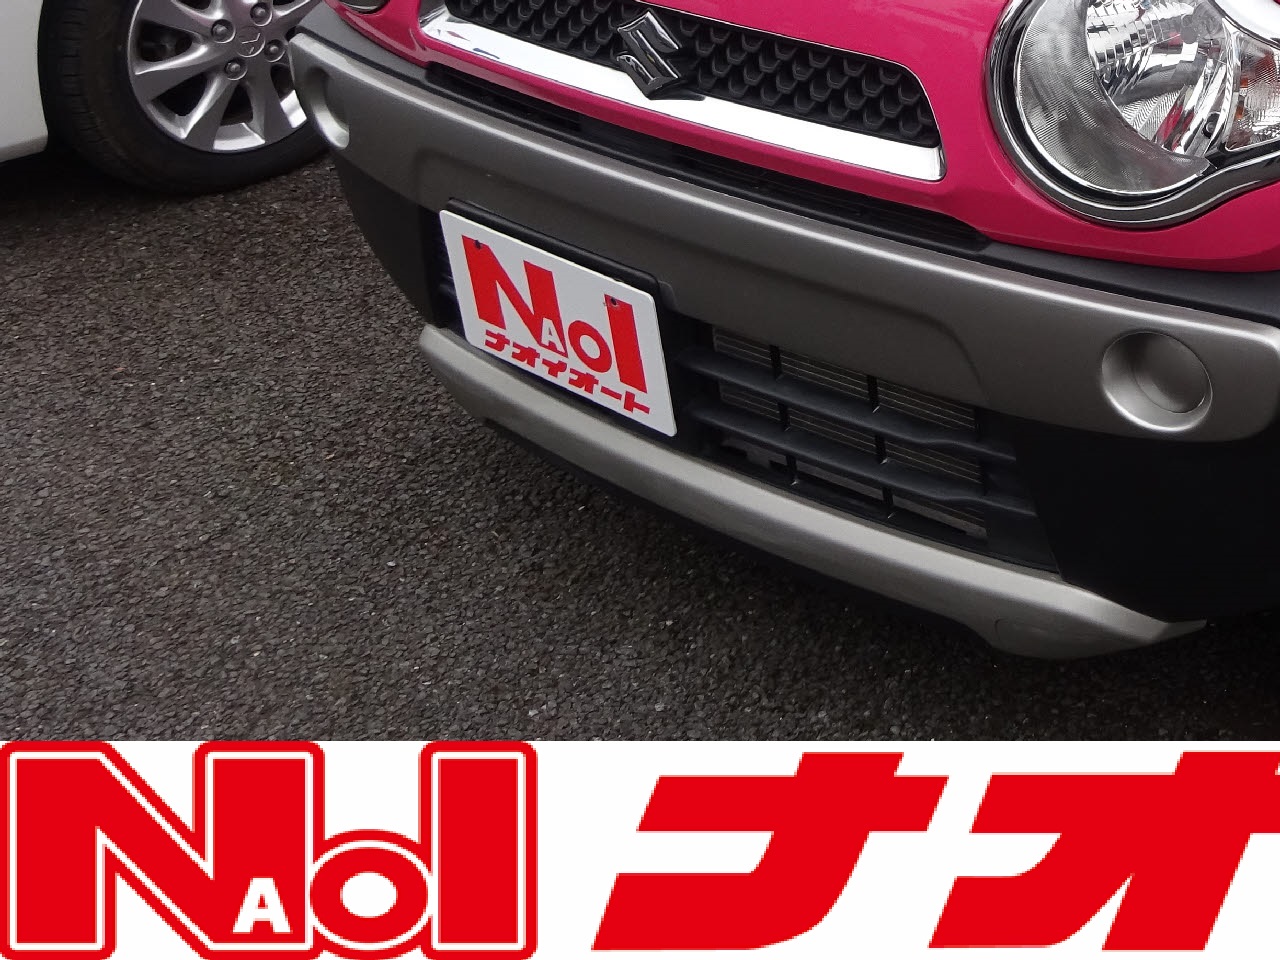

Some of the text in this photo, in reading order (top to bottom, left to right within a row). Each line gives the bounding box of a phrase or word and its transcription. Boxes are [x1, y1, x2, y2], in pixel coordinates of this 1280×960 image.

[485, 329, 651, 415] ナオイオート
